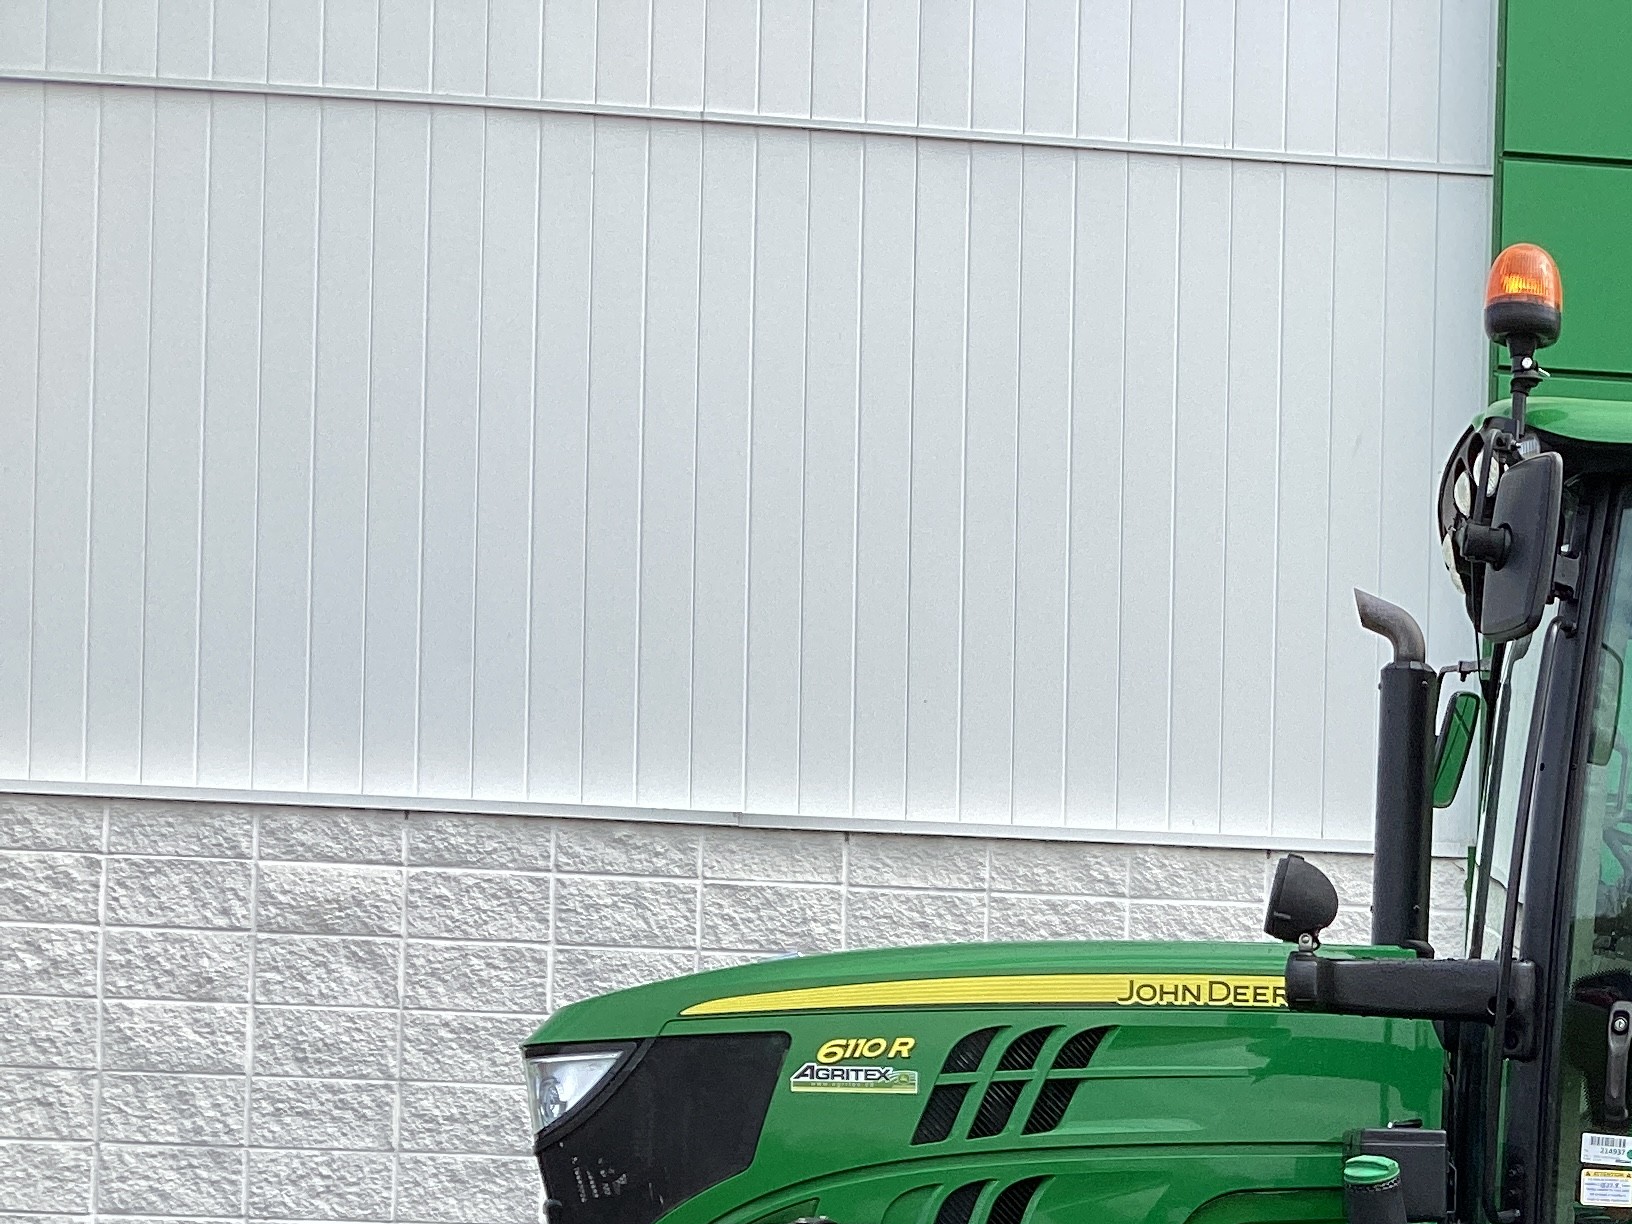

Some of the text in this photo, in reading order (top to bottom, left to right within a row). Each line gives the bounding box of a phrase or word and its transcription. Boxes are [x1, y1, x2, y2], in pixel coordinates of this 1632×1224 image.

[1117, 980, 1287, 1004] JOHN DEER
[794, 1065, 891, 1081] AGRITEX
